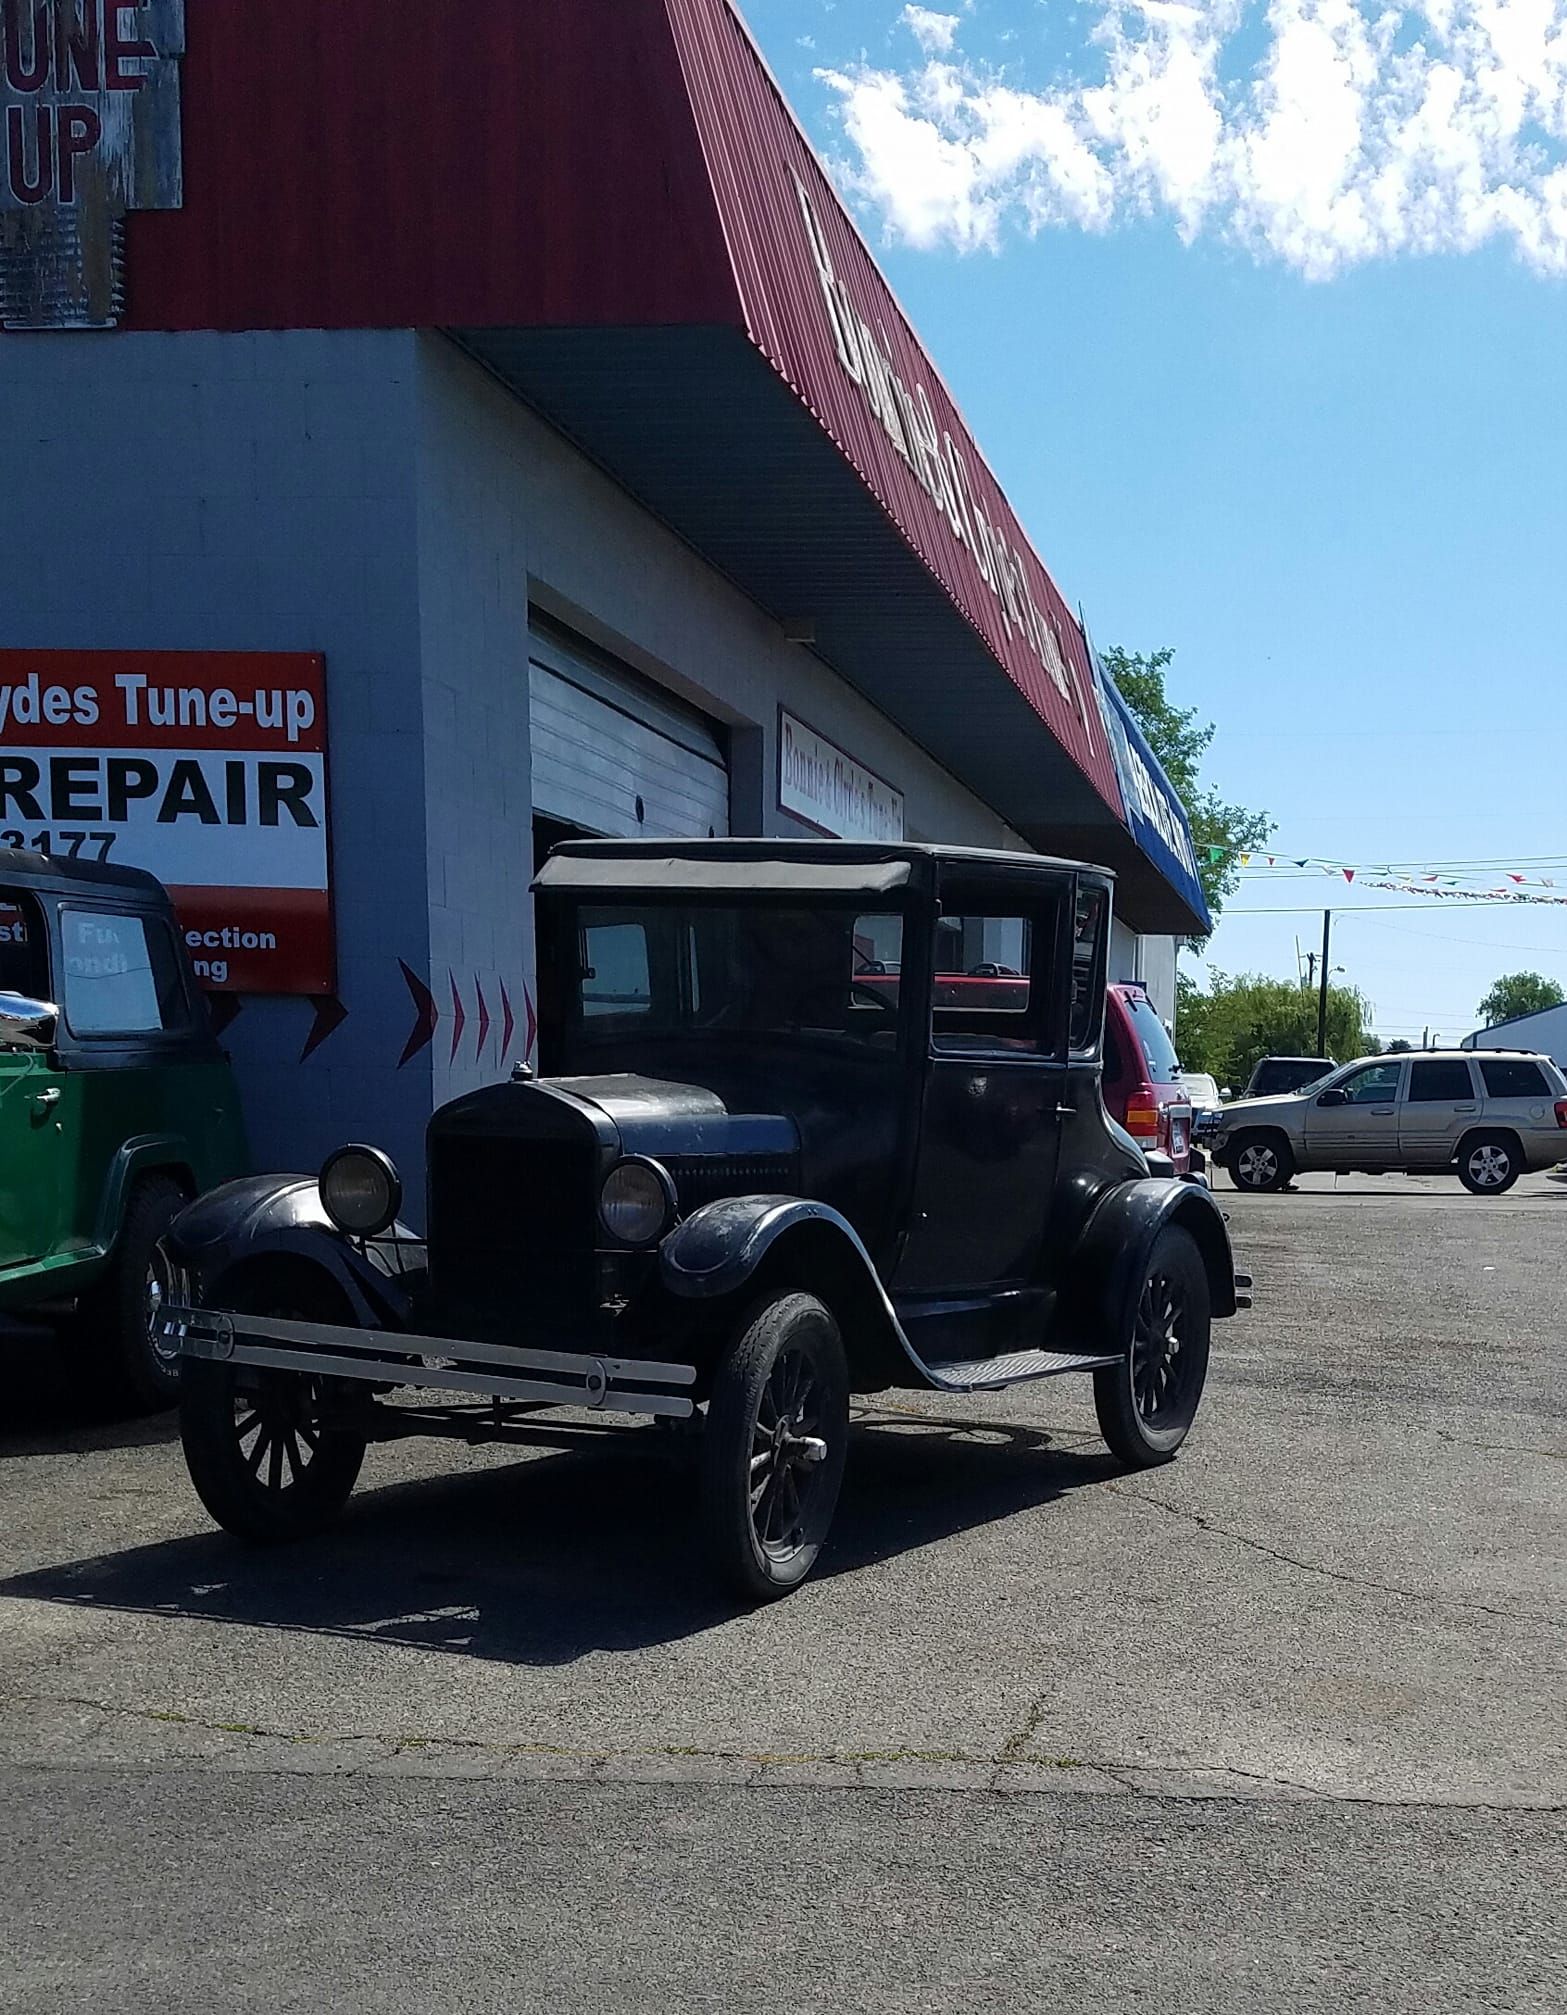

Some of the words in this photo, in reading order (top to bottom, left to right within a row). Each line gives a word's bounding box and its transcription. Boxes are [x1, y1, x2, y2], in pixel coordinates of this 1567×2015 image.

[5, 0, 156, 92] UNE
[6, 105, 101, 204] UP
[115, 674, 315, 741] Tune-up
[0, 757, 319, 828] REPAIR
[784, 721, 824, 805] Bonnie
[181, 927, 276, 950] ection
